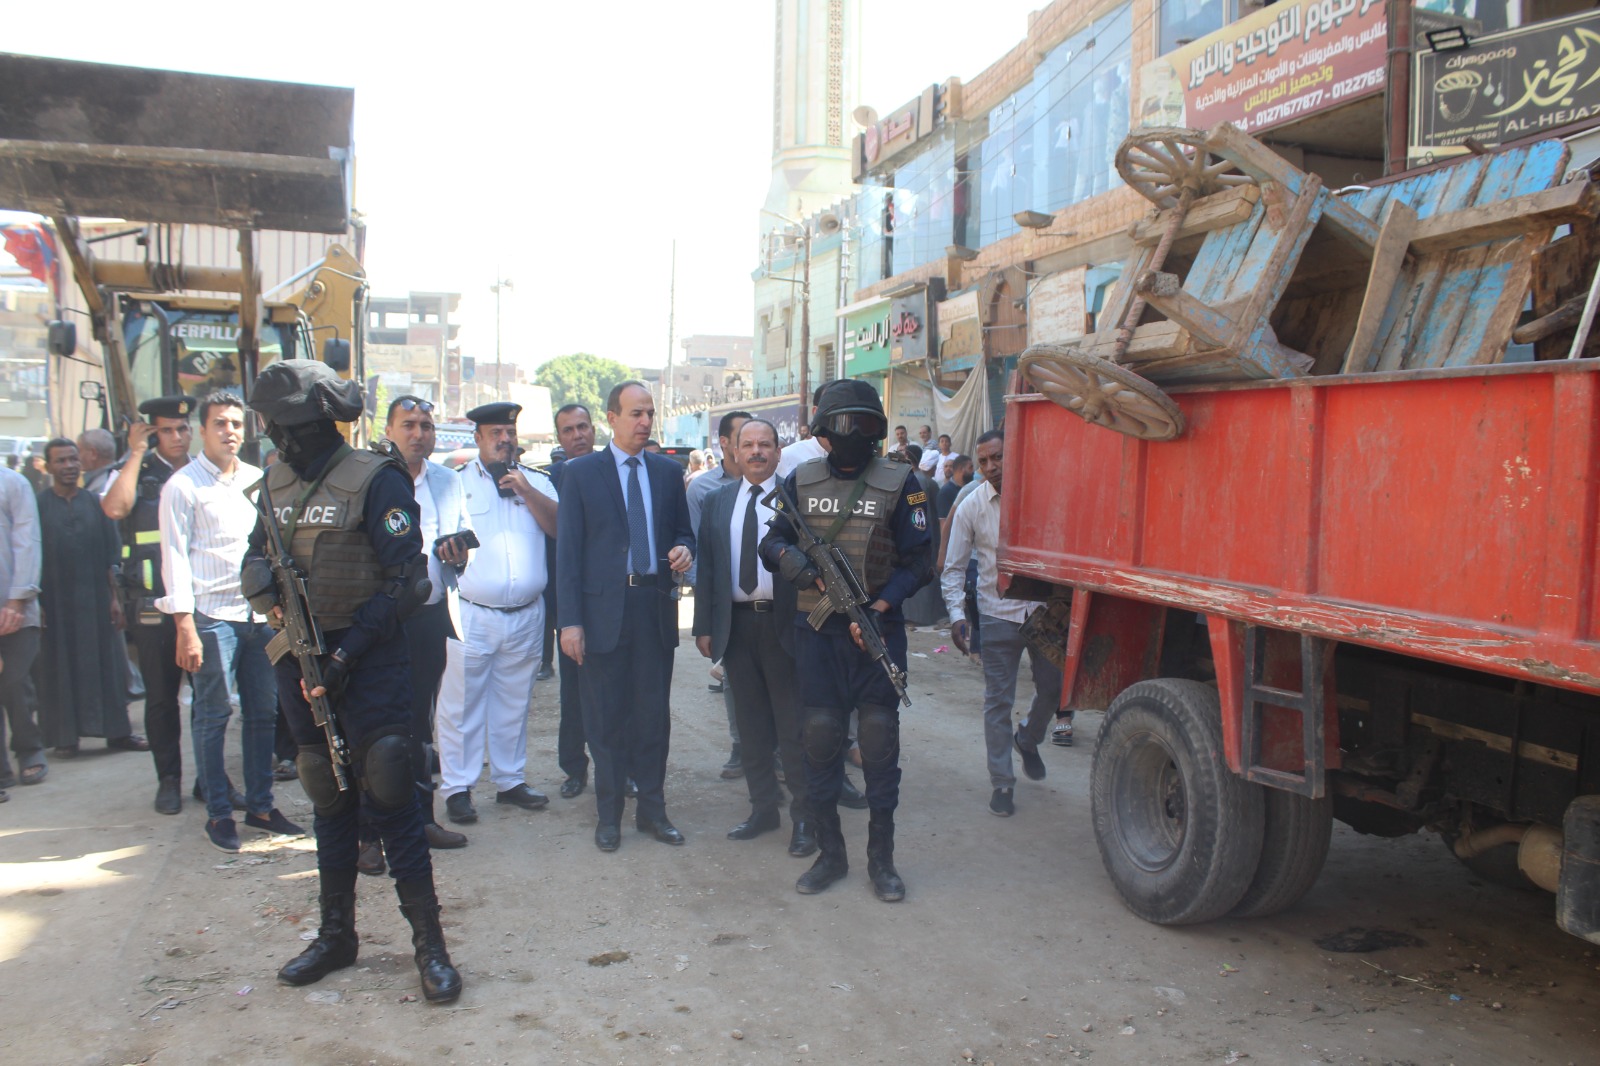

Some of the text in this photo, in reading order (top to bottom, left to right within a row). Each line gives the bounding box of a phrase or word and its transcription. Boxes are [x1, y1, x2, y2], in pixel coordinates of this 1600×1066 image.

[1236, 5, 1301, 64] التوحيد
[1297, 35, 1354, 70] والمفروشات
[1189, 40, 1234, 89] والنور
[1244, 65, 1334, 112] وتجهيز العرائس
[808, 497, 876, 516] POLCE
